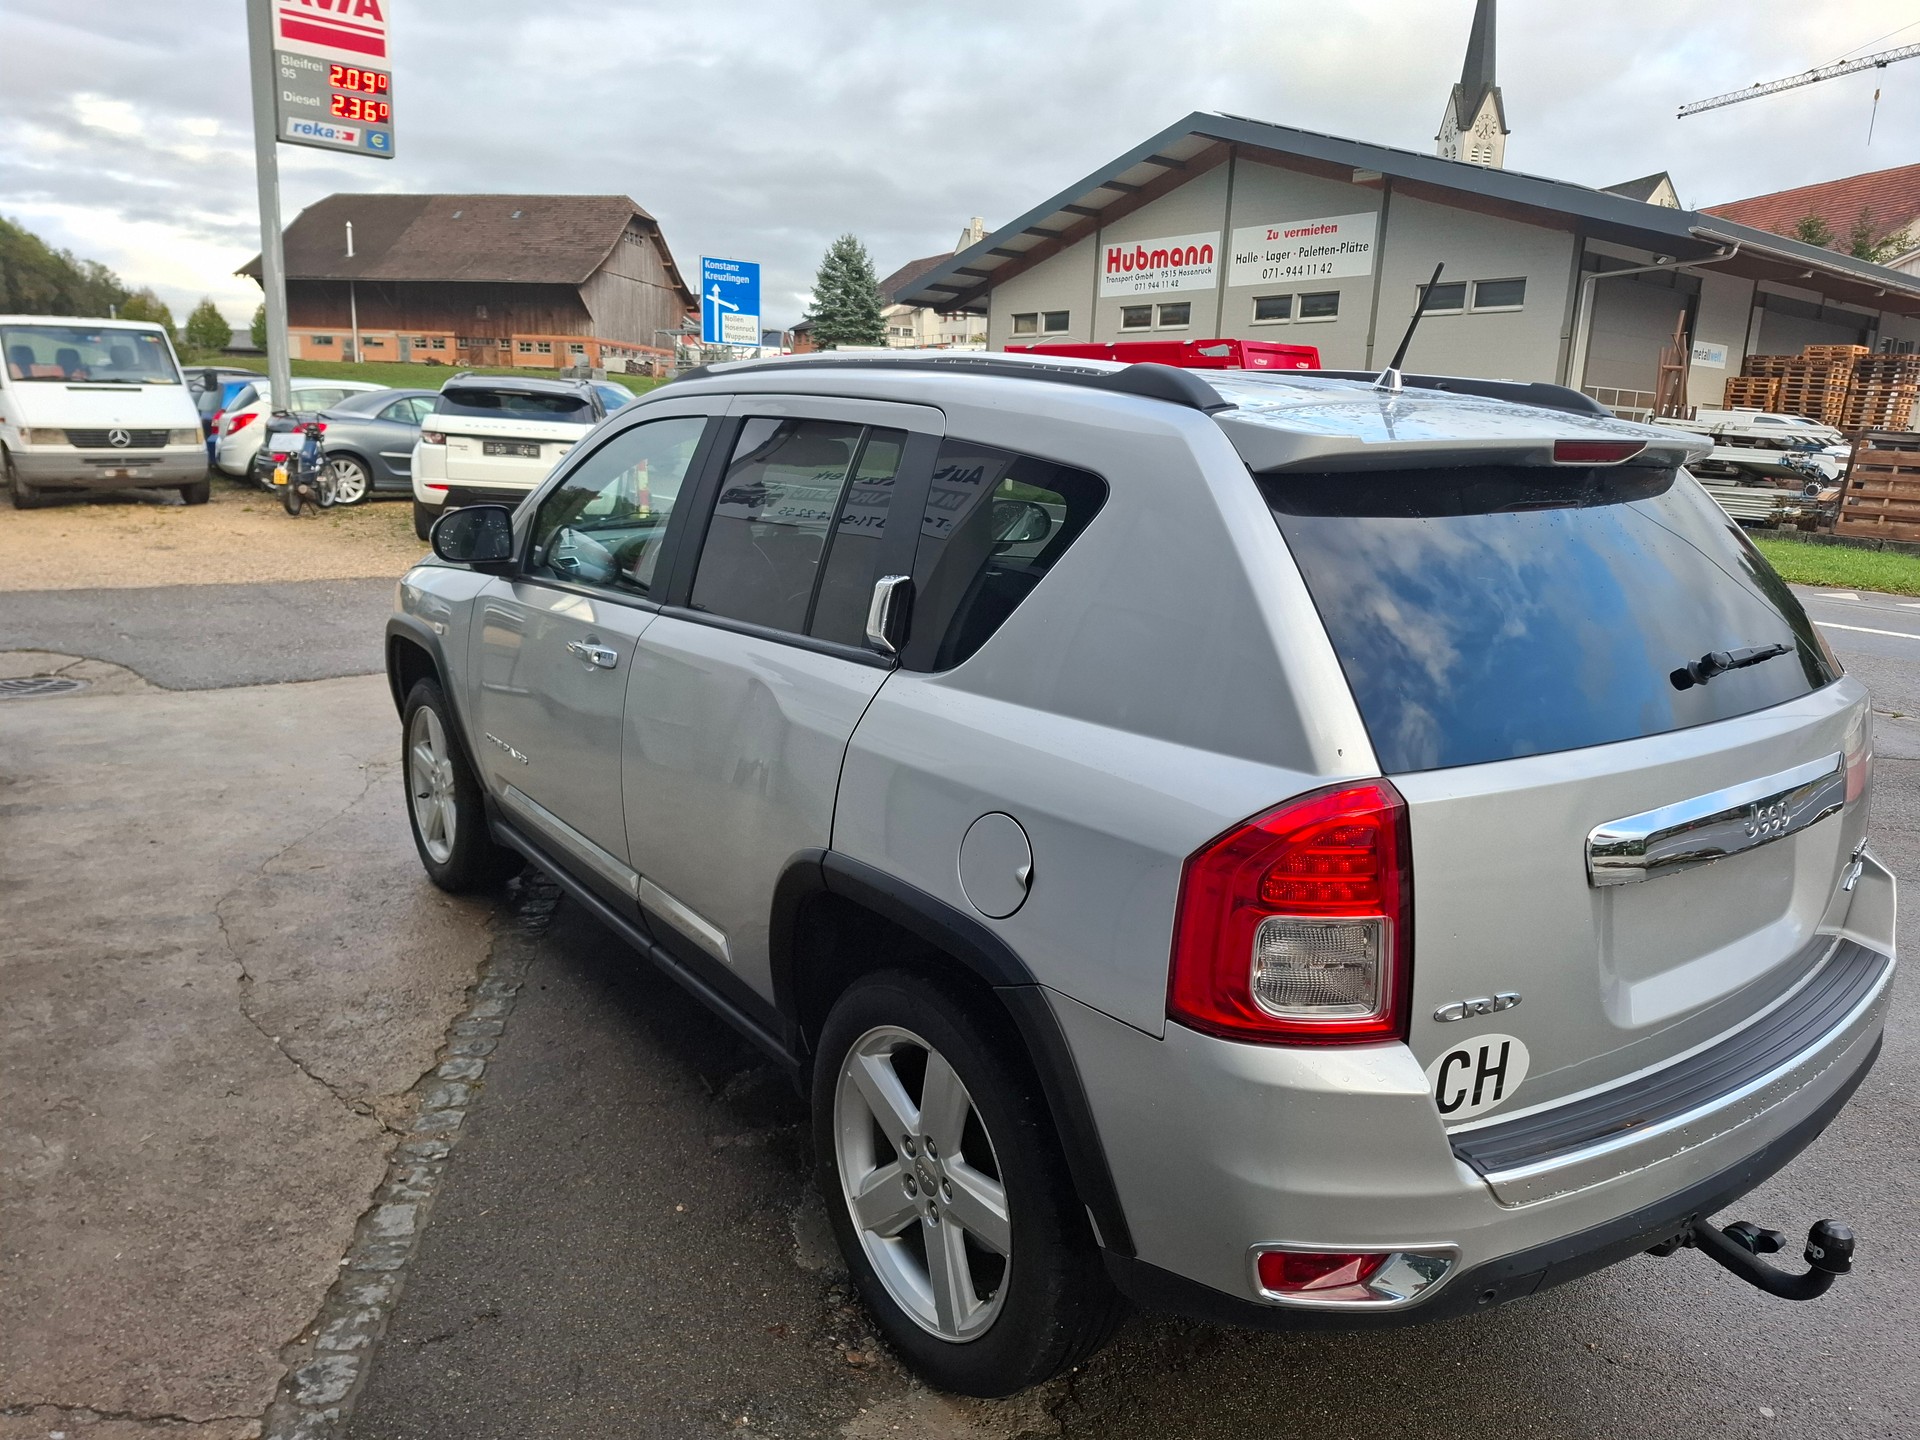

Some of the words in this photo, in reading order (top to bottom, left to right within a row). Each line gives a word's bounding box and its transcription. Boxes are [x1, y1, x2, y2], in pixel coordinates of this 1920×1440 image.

[281, 54, 324, 72] Bleifrei
[281, 67, 297, 79] 95
[283, 91, 321, 107] Diesel
[1266, 229, 1279, 241] Zu
[1284, 223, 1338, 239] vermieten
[1106, 244, 1214, 274] Hubmann
[1235, 252, 1259, 264] Halle
[1266, 250, 1291, 264] Lager
[1298, 241, 1369, 258] Paletten-Plätze
[705, 260, 740, 272] Konstanz
[1307, 264, 1317, 275] 11
[1320, 262, 1333, 274] 42
[705, 271, 750, 285] Kreuzlingen
[1106, 274, 1134, 284] Transport
[1135, 272, 1154, 281] GmbH
[1161, 269, 1177, 279] 9515
[1134, 282, 1146, 291] 071
[1162, 280, 1169, 289] 11
[1171, 279, 1179, 288] 42
[1744, 801, 1791, 839] Jeep
[1433, 991, 1523, 1022] CRD
[1435, 1041, 1511, 1114] CH
